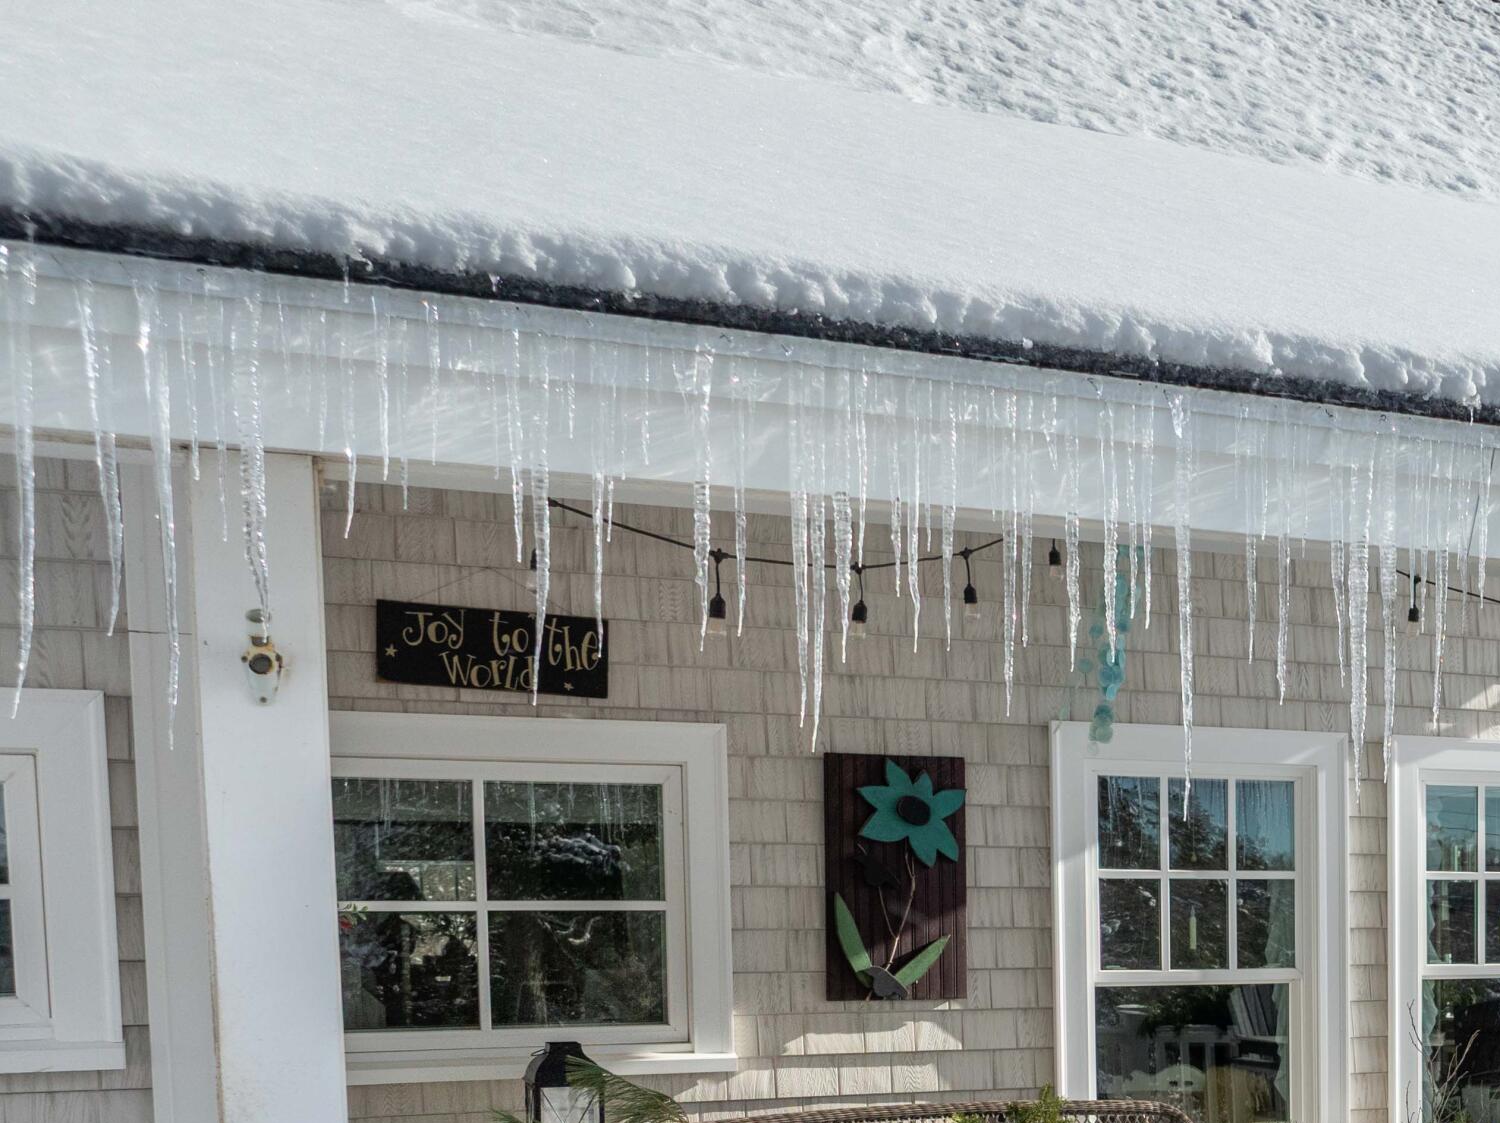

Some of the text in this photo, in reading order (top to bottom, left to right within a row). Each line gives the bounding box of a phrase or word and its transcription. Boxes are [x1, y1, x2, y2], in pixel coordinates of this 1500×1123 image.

[402, 609, 600, 671] Joy to the
